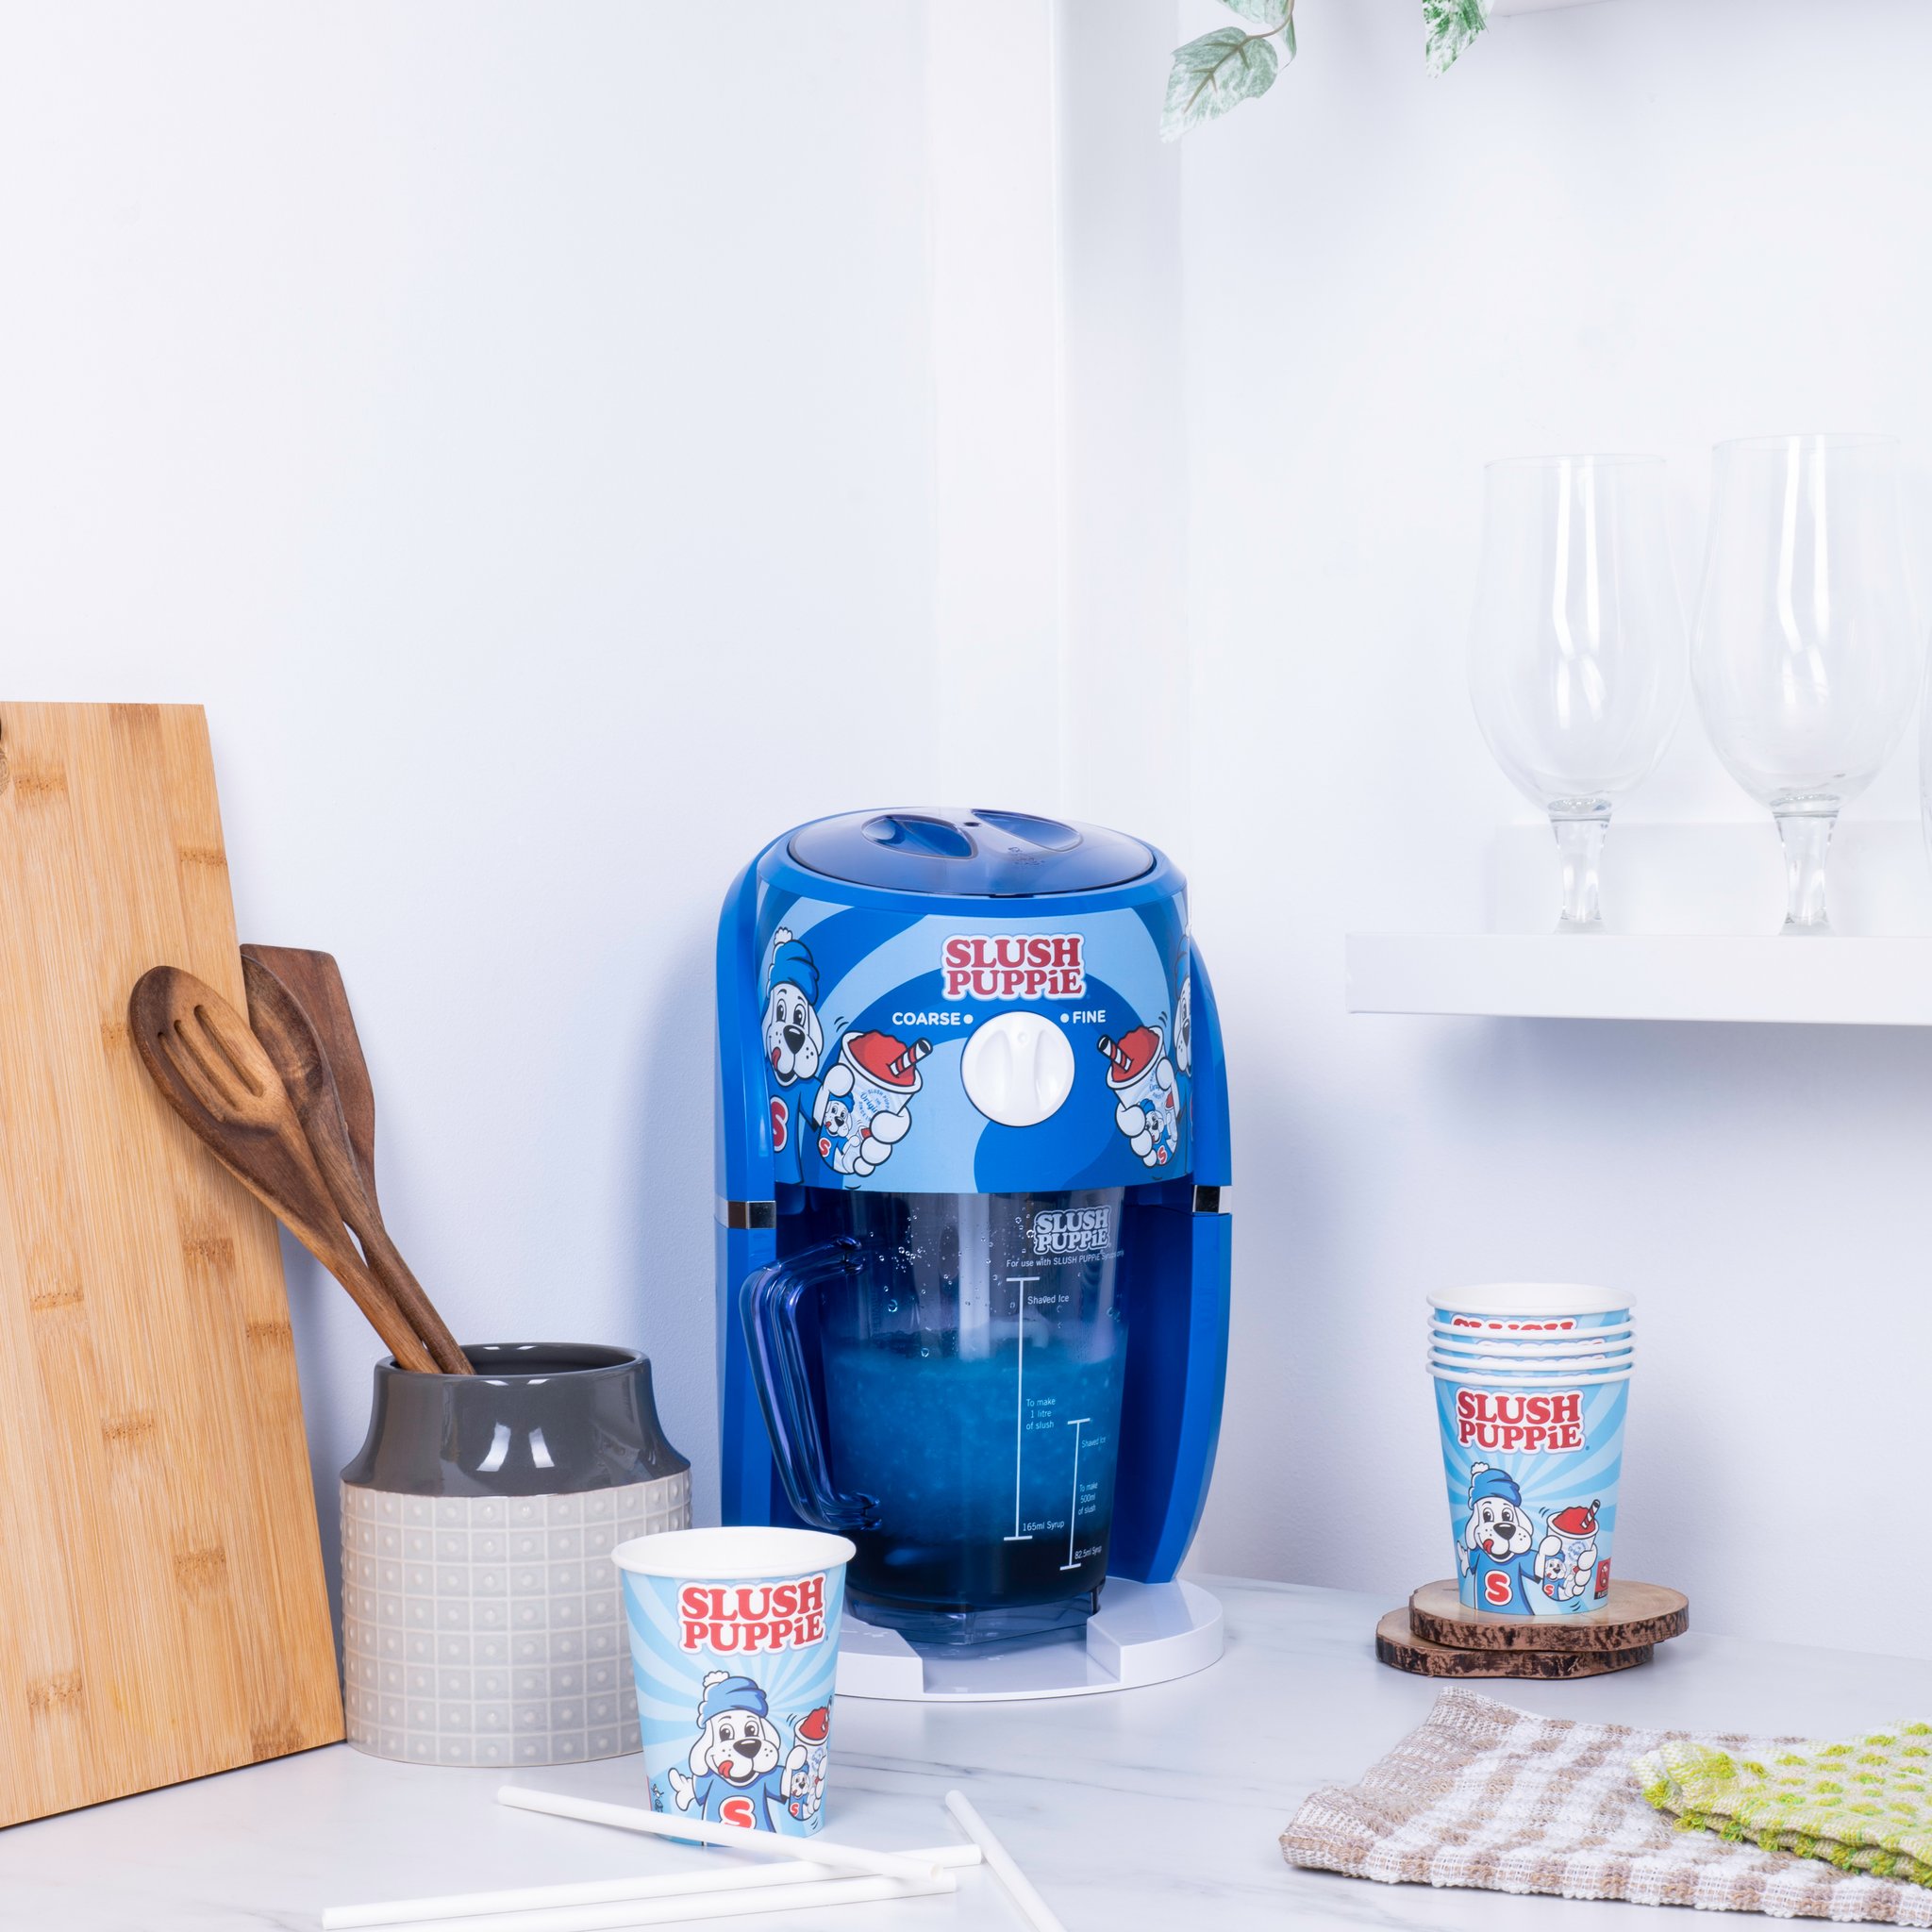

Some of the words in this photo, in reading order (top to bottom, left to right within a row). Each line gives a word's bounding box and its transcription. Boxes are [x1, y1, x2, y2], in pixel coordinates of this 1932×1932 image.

[945, 937, 1081, 968] SLUSH
[891, 1011, 961, 1026] COARSE
[1072, 1009, 1107, 1024] FINE
[1036, 1207, 1110, 1234] SLUSH
[1006, 1258, 1020, 1268] For
[1021, 1259, 1035, 1268] use
[1036, 1257, 1052, 1267] with
[1053, 1256, 1077, 1265] SLUSH
[1027, 1295, 1056, 1305] Shaved
[1058, 1294, 1070, 1303] Ice
[1025, 1398, 1035, 1407] To
[1037, 1397, 1057, 1407] make
[1457, 1390, 1582, 1425] SLUSH
[1037, 1409, 1052, 1418] litre
[1025, 1422, 1034, 1430] of
[1035, 1421, 1055, 1430] slush
[1079, 1484, 1086, 1492] To
[1080, 1492, 1096, 1504] 500ml
[1077, 1506, 1084, 1515] of
[1022, 1521, 1045, 1532] 165ml
[1046, 1519, 1065, 1531] Syrup
[1074, 1548, 1091, 1560] 82.5ml
[1487, 1572, 1510, 1604] S
[1543, 1585, 1554, 1595] S
[681, 1576, 825, 1621] SLUSH
[791, 1803, 799, 1817] S
